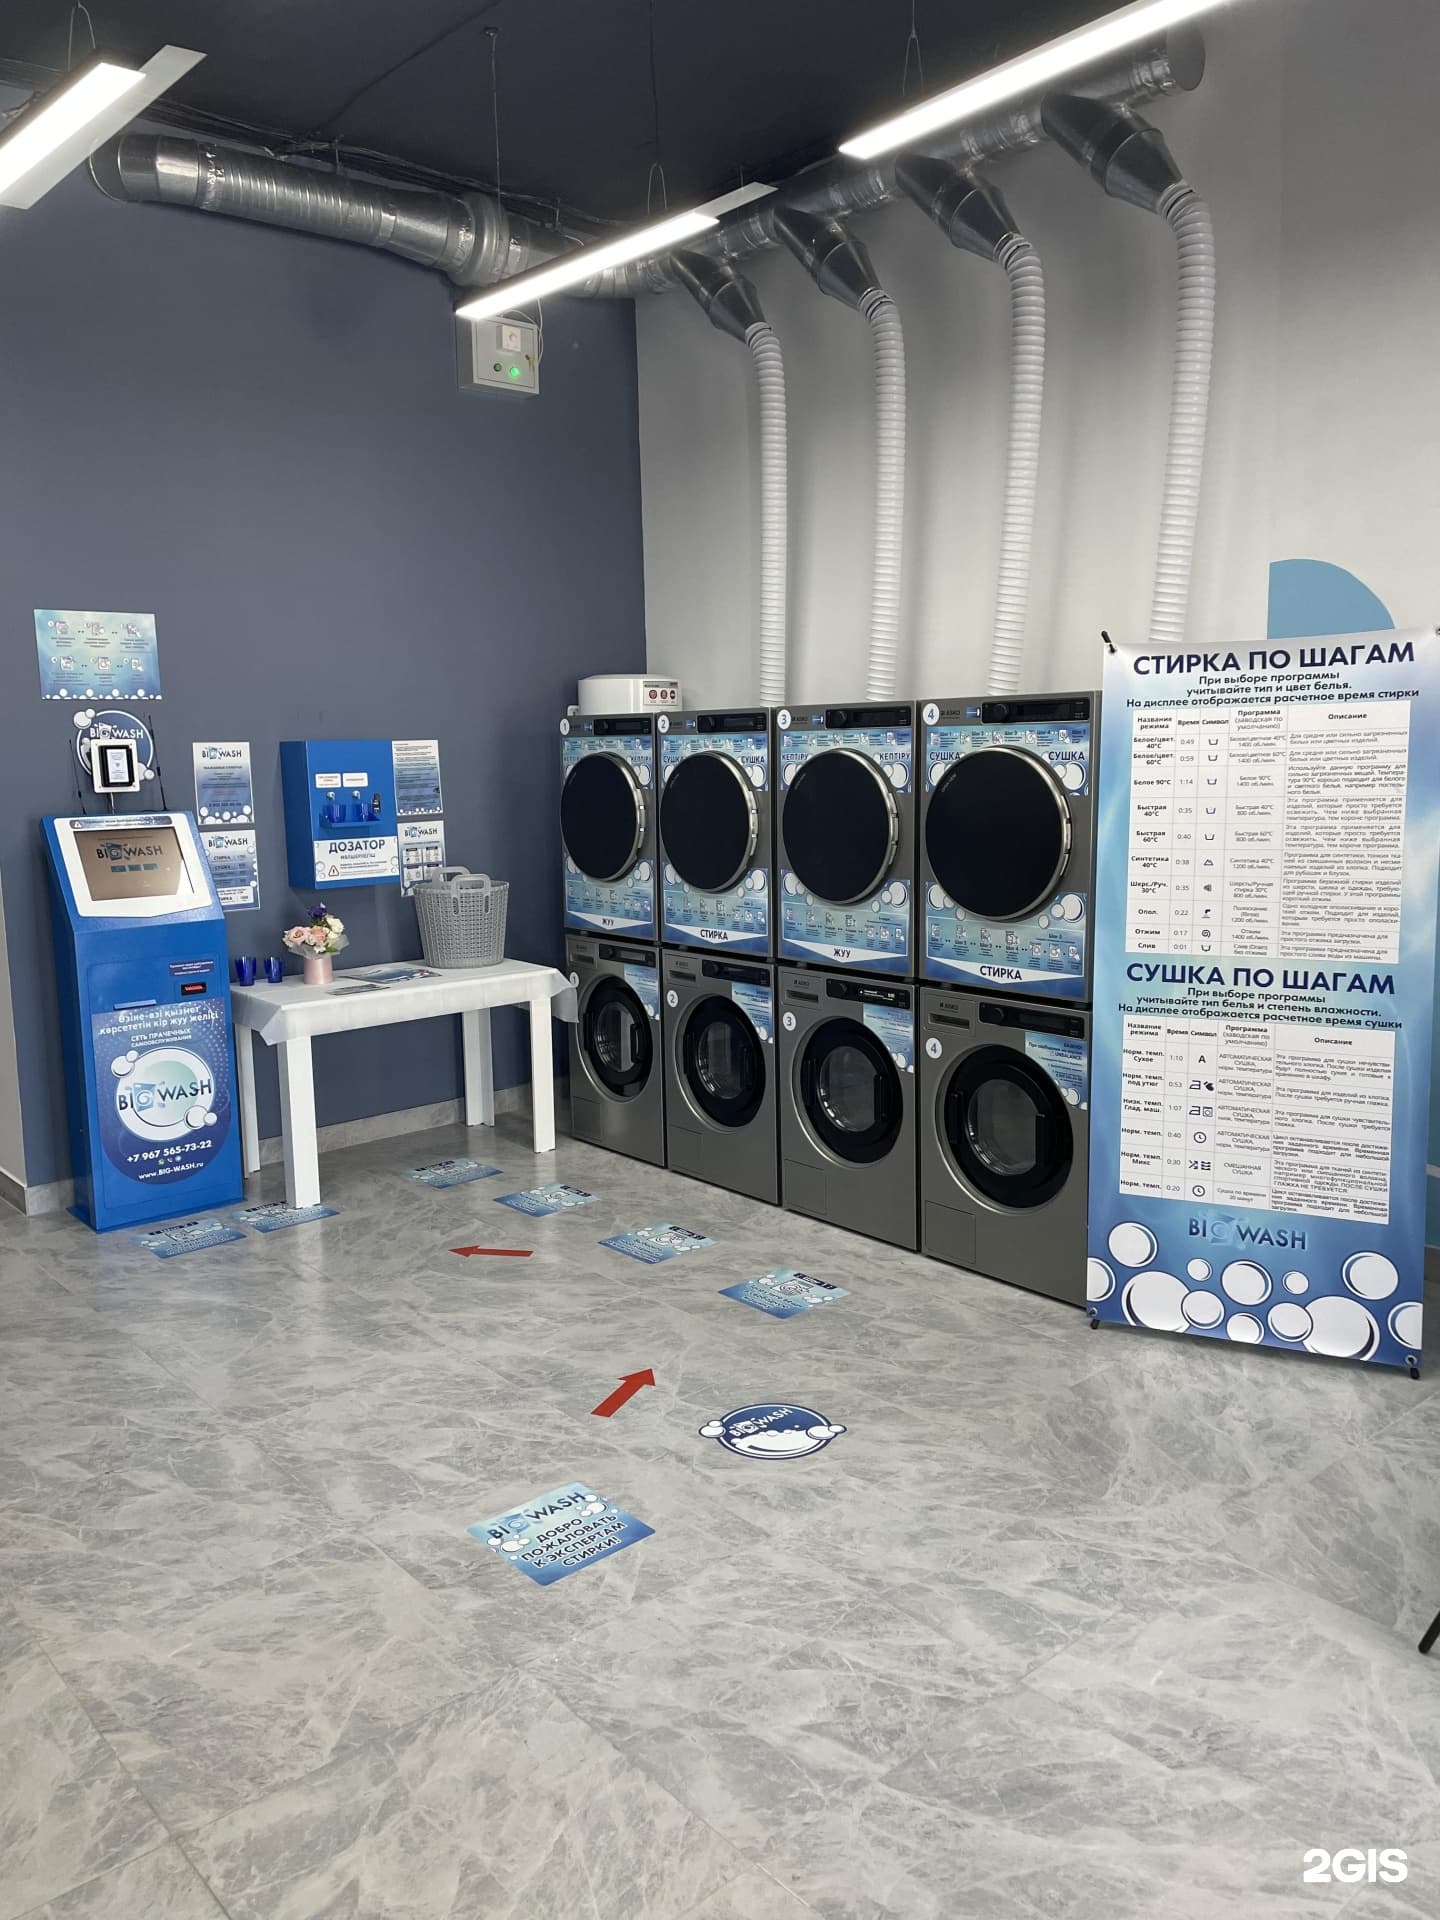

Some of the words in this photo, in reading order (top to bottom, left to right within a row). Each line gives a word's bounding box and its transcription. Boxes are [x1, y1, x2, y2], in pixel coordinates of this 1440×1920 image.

[1133, 652, 1241, 675] СТИРКА
[1249, 650, 1291, 670] ПО
[1299, 642, 1414, 668] ШАГАМ
[1199, 676, 1221, 686] При
[1224, 674, 1268, 685] выборе
[1270, 672, 1340, 683] программы
[1186, 685, 1252, 697] учитывайте
[1285, 683, 1311, 693] цвет
[1314, 681, 1352, 690] белья.
[1127, 699, 1141, 707] На
[1144, 699, 1189, 708] дисплее
[1191, 695, 1271, 706] отображается
[1274, 693, 1335, 705] расчетное
[1338, 692, 1375, 702] время
[1378, 690, 1419, 700] стирки
[781, 714, 787, 724] 3
[927, 708, 935, 720] 4
[1238, 709, 1281, 717] Программа
[660, 719, 667, 729] 2
[740, 755, 765, 764] СУШКА
[929, 751, 961, 761] СУШКА
[1048, 751, 1085, 761] СУШКА
[328, 839, 386, 854] ДОЗАТОР
[699, 929, 728, 941] СТИРКА
[833, 948, 851, 959] ЖУУ
[979, 965, 1023, 981] СТИРКА
[1126, 962, 1225, 986] СУШКА
[1233, 968, 1275, 988] ПО
[1282, 970, 1395, 995] ШАГАМ
[669, 994, 675, 1003] 2
[1187, 987, 1210, 998] При
[1212, 989, 1255, 1000] выборе
[1258, 993, 1326, 1003] программы
[1136, 996, 1199, 1006] учитывайте
[1222, 999, 1255, 1009] белья
[1267, 1004, 1312, 1013] степень
[1314, 1007, 1381, 1017] влажности.
[153, 1018, 167, 1030] кір
[170, 1017, 188, 1027] жуу
[190, 1010, 219, 1022] желісі
[786, 1016, 793, 1026] 3
[1118, 1003, 1133, 1012] На
[1135, 1005, 1179, 1015] дисплее
[1182, 1008, 1260, 1019] отображается
[1263, 1013, 1323, 1023] расчетное
[1326, 1017, 1362, 1026] время
[1365, 1021, 1402, 1030] сушки
[1127, 1022, 1162, 1030] Название
[1225, 1025, 1268, 1033] Программа
[131, 1034, 148, 1042] СЕТЬ
[148, 1028, 191, 1040] ПРАЧЕЧНЫХ
[1314, 1037, 1353, 1045] Описание
[930, 1042, 937, 1054] 4
[127, 1154, 140, 1163] +7
[142, 1149, 160, 1161] 967
[163, 1139, 212, 1157] 565-73-22
[138, 1161, 204, 1180] www.BIG-WASH.ru
[521, 1514, 617, 1561] ПОЖАЛОВАТЬ
[536, 1518, 583, 1544] ДОБРО
[534, 1558, 546, 1568] К
[546, 1522, 626, 1562] ЭКСПЕРТАМ
[563, 1536, 621, 1567] СТИРКИ!
